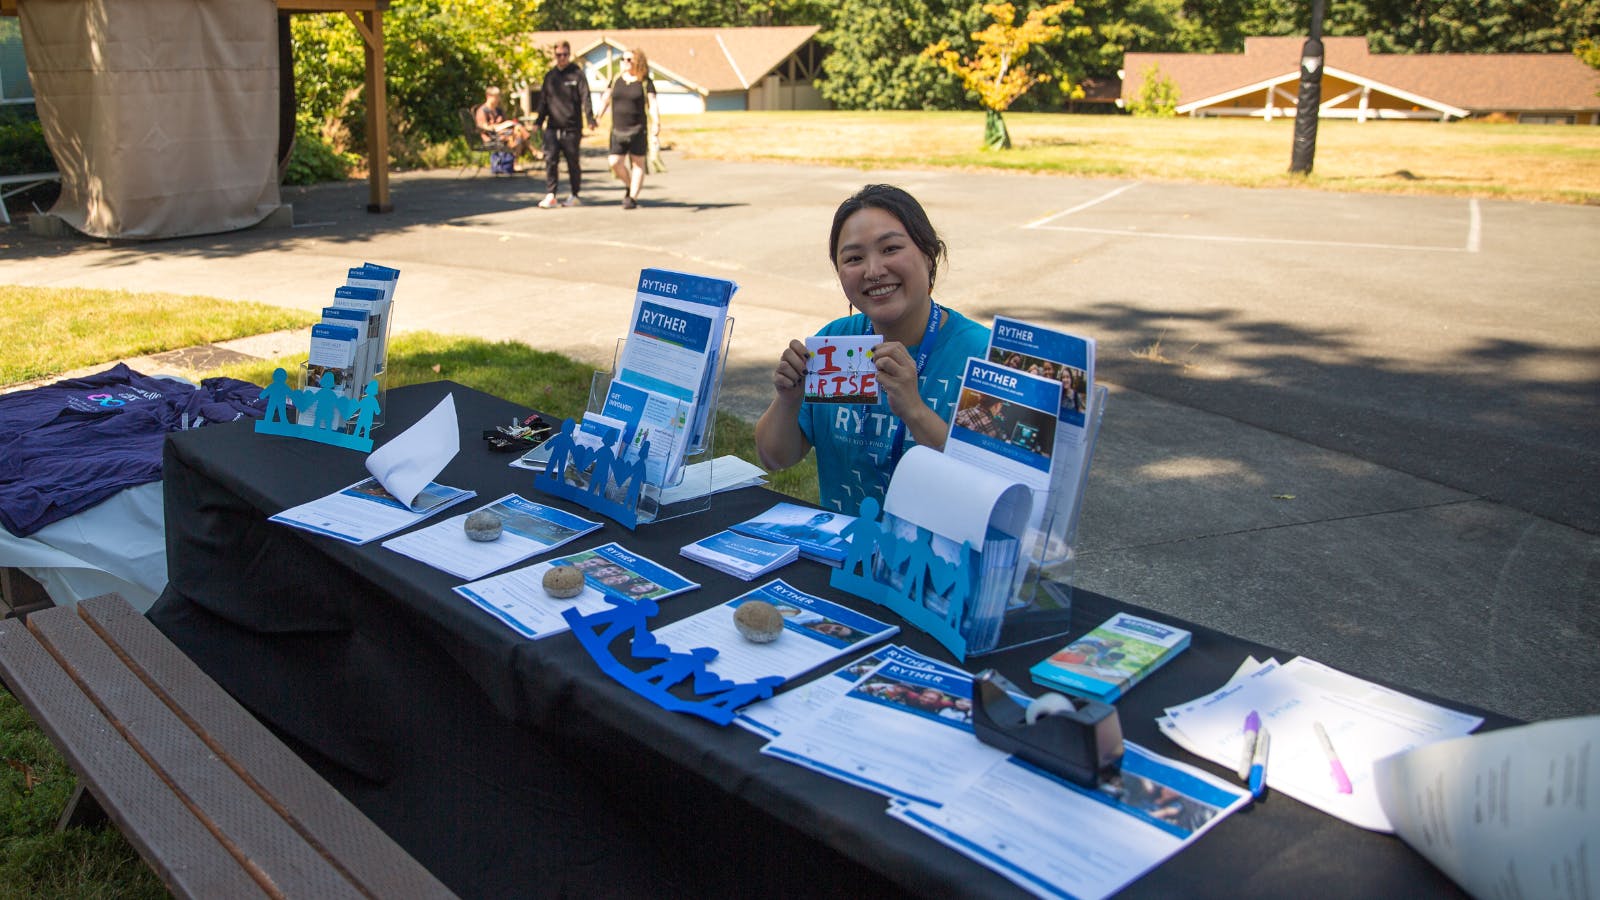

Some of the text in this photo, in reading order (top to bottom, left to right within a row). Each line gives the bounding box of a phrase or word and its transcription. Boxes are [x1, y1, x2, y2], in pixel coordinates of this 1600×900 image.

[641, 279, 679, 295] RYTHER
[641, 309, 688, 334] RYTHER
[998, 325, 1034, 342] RYTHER
[817, 345, 841, 376] I
[817, 373, 877, 397] RISE
[972, 366, 1018, 389] RYTHER
[834, 406, 915, 441] RYTH
[605, 547, 637, 563] RYTHER
[773, 584, 815, 605] RYTHER
[886, 649, 936, 671] RYTHER
[889, 665, 944, 683] RYTHER
